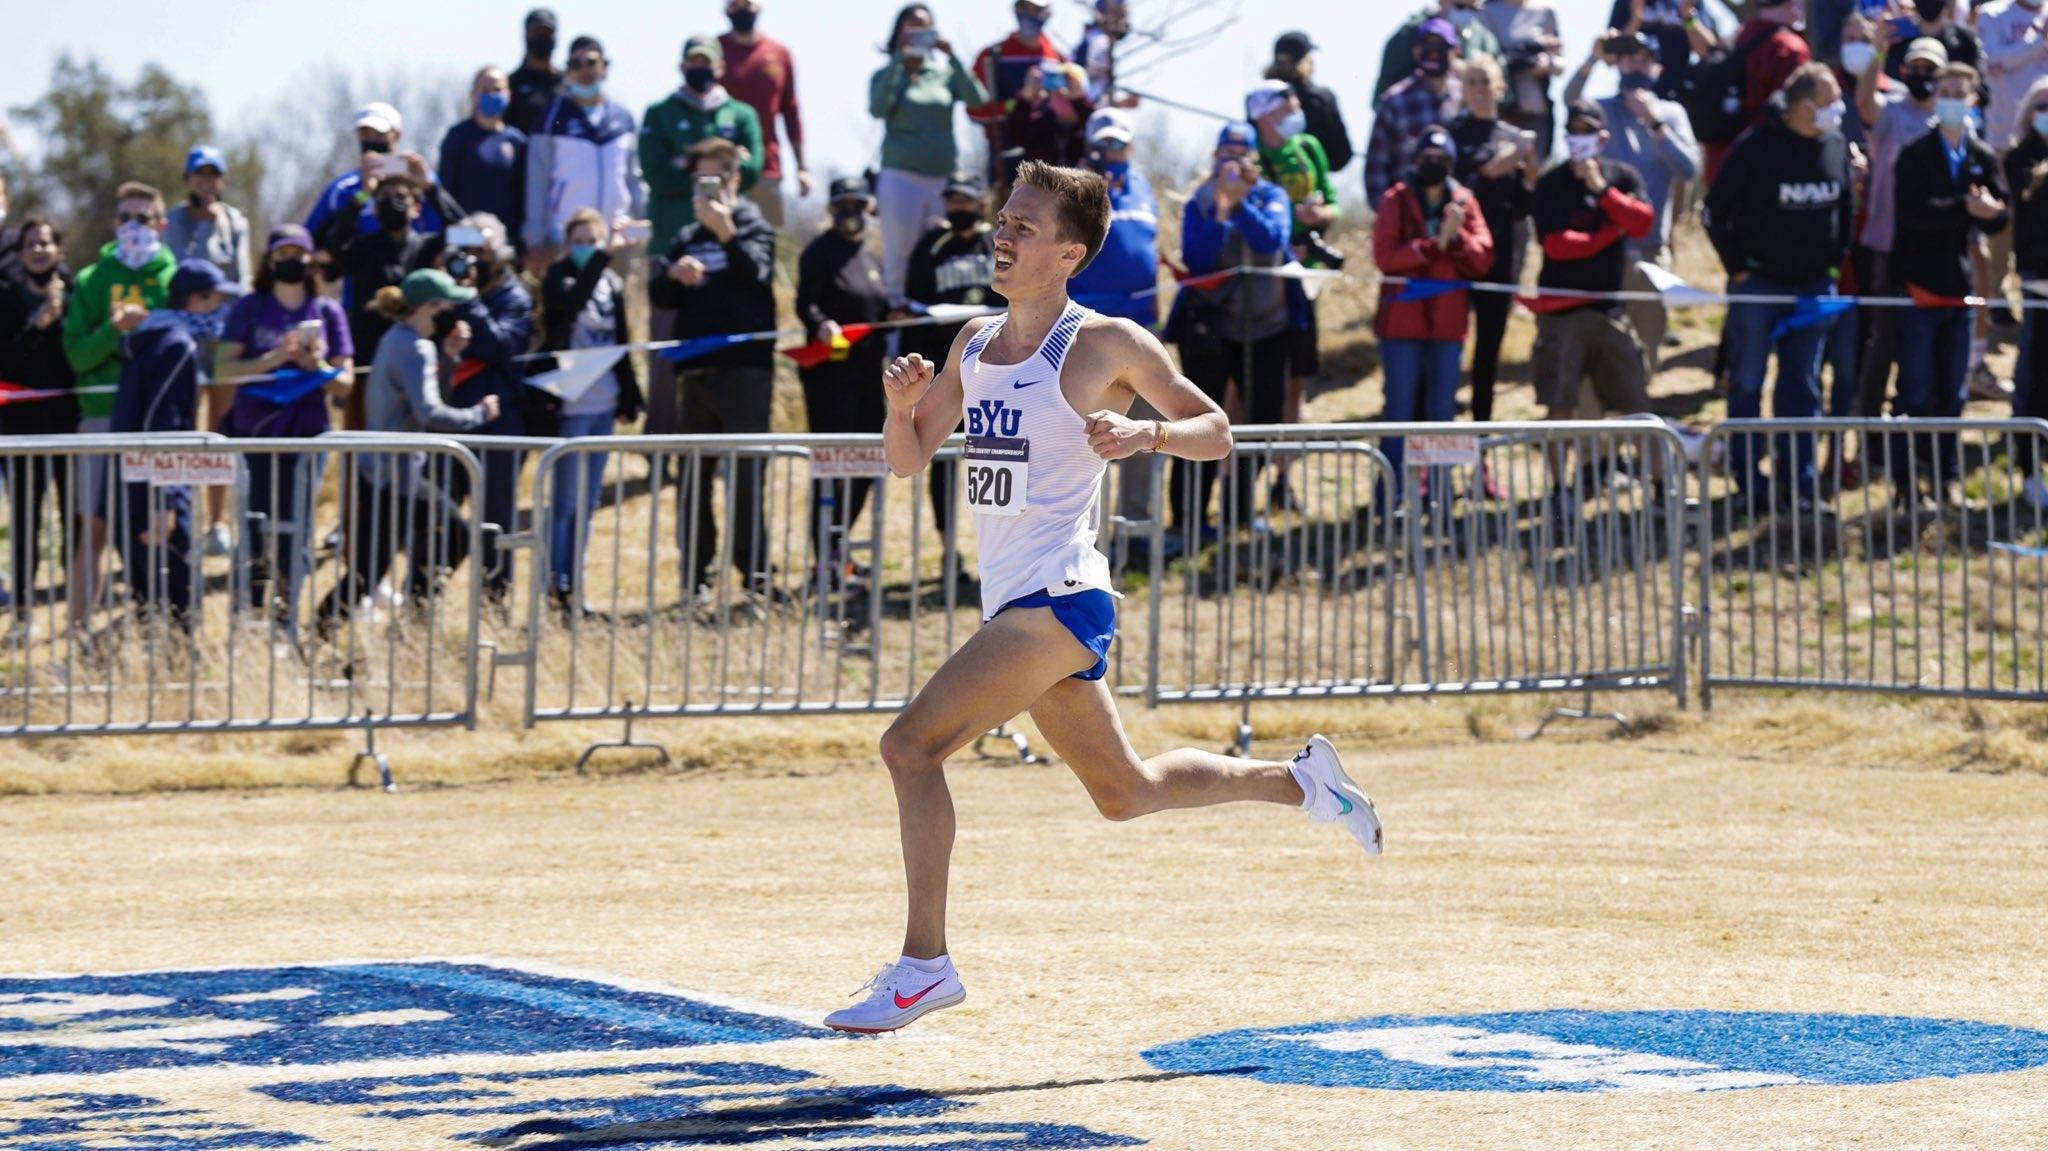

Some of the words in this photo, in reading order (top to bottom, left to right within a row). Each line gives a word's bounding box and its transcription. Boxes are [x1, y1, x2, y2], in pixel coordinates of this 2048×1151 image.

[1780, 181, 1840, 204] NAU
[967, 400, 1023, 438] BYU
[154, 453, 232, 470] NATIONAL
[813, 448, 885, 463] NATIONAL
[967, 466, 1013, 507] 520
